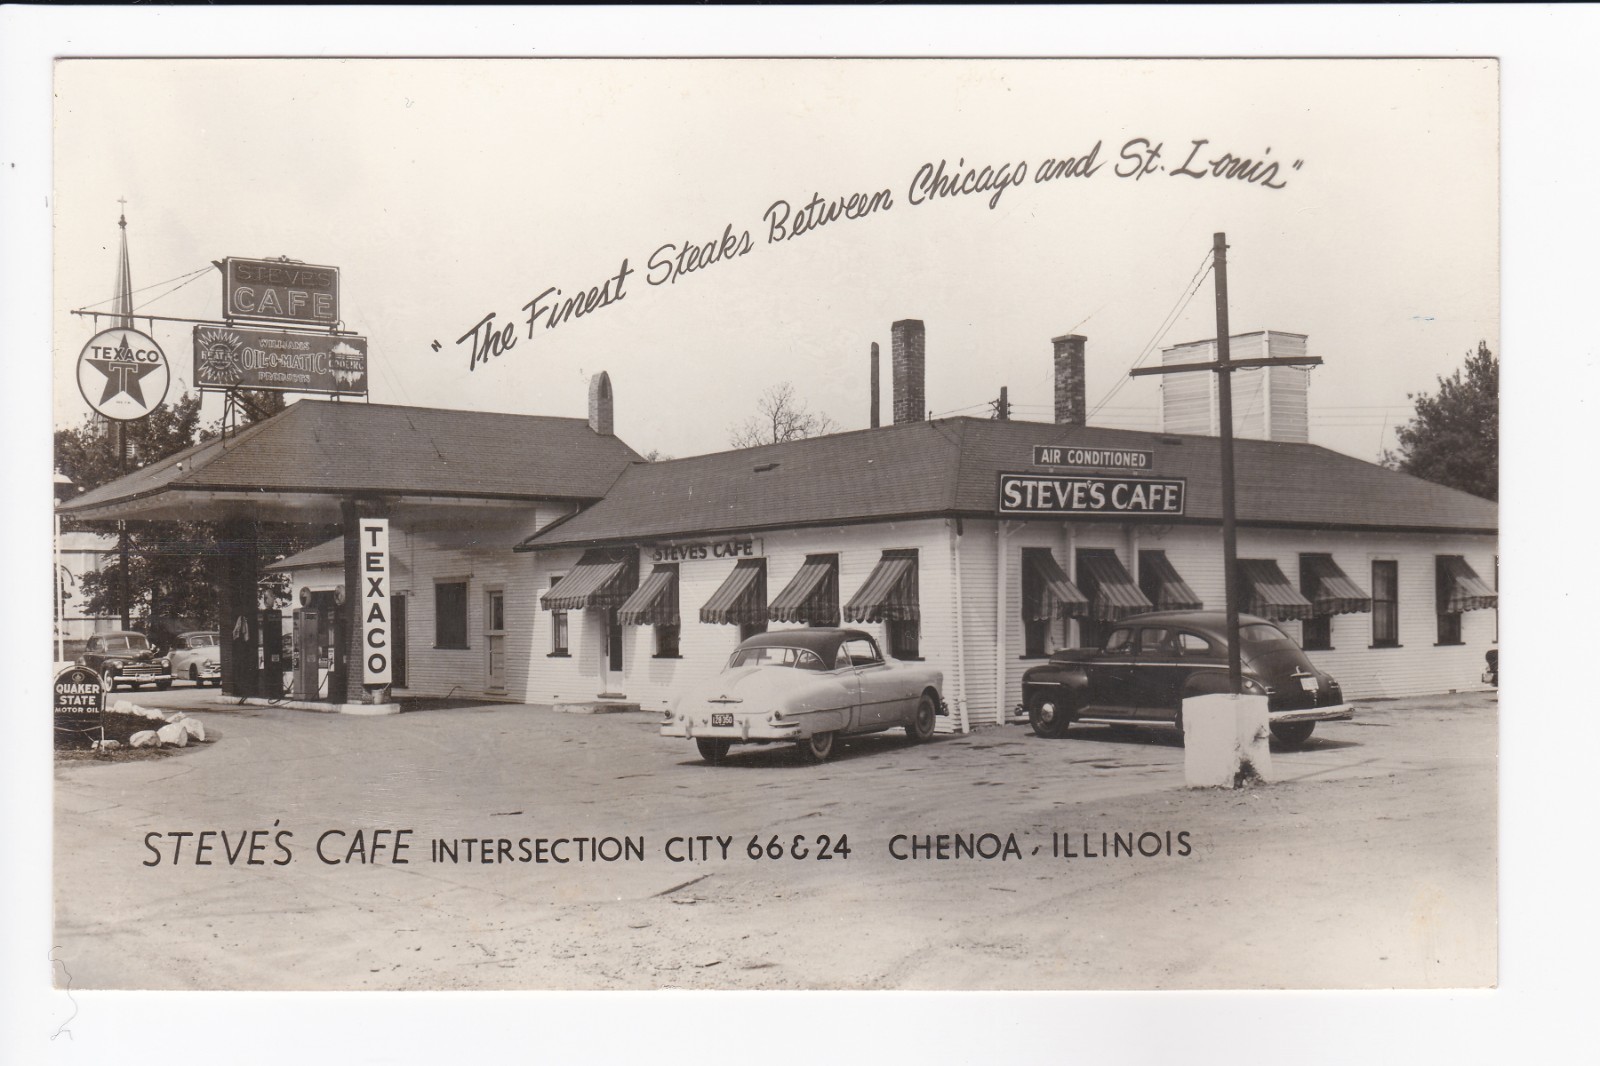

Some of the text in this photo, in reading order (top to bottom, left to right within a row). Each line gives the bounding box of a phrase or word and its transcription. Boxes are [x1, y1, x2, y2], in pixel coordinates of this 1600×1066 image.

[234, 286, 333, 318] CAFE
[91, 346, 159, 362] TEXACO
[241, 347, 327, 374] OIL-O-MATIC
[1041, 448, 1146, 467] AIR CONDITIONED
[1004, 480, 1178, 511] STEVE'S CAFE
[713, 540, 753, 558] CAFE
[364, 526, 387, 674] TEXACO
[56, 683, 100, 694] QUAKER
[60, 695, 96, 705] STATE
